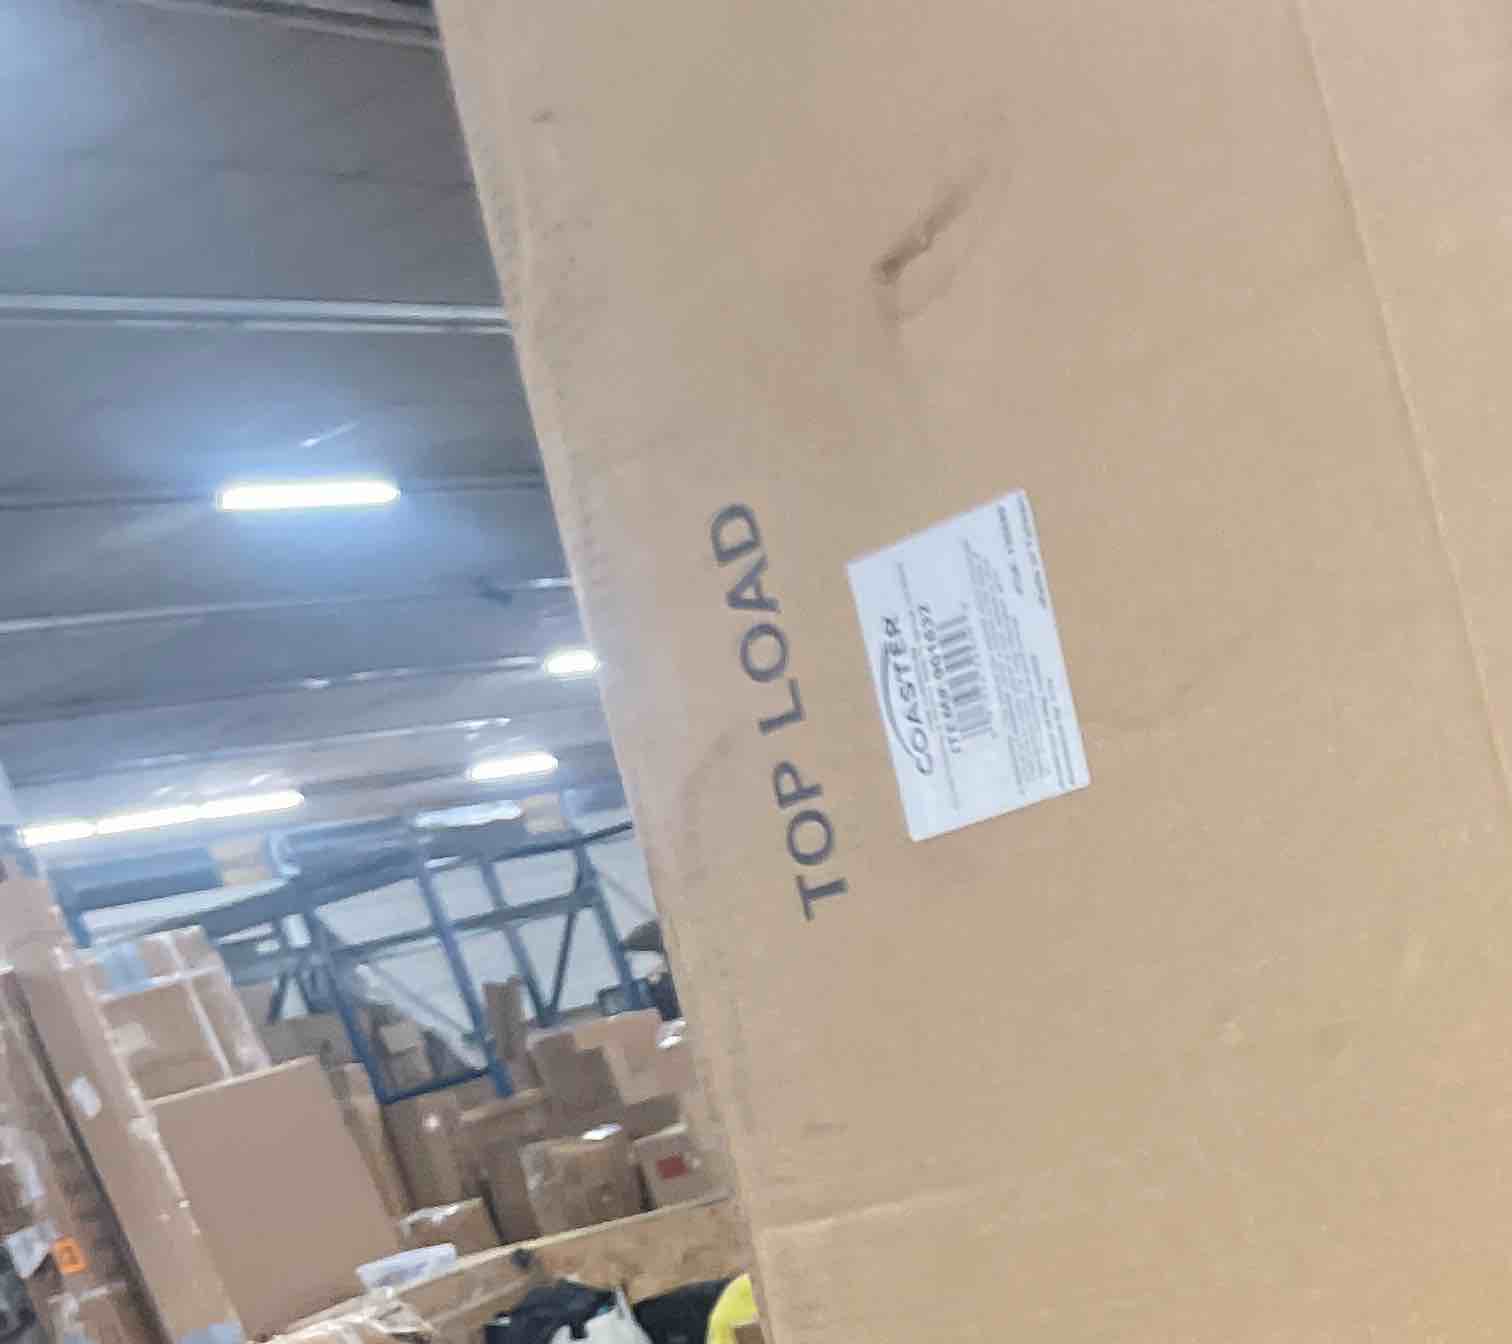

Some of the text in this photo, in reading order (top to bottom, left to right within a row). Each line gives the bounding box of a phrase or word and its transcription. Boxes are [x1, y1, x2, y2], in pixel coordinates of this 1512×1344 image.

[711, 503, 848, 921] TOP LOAD
[880, 615, 934, 776] COASTER
